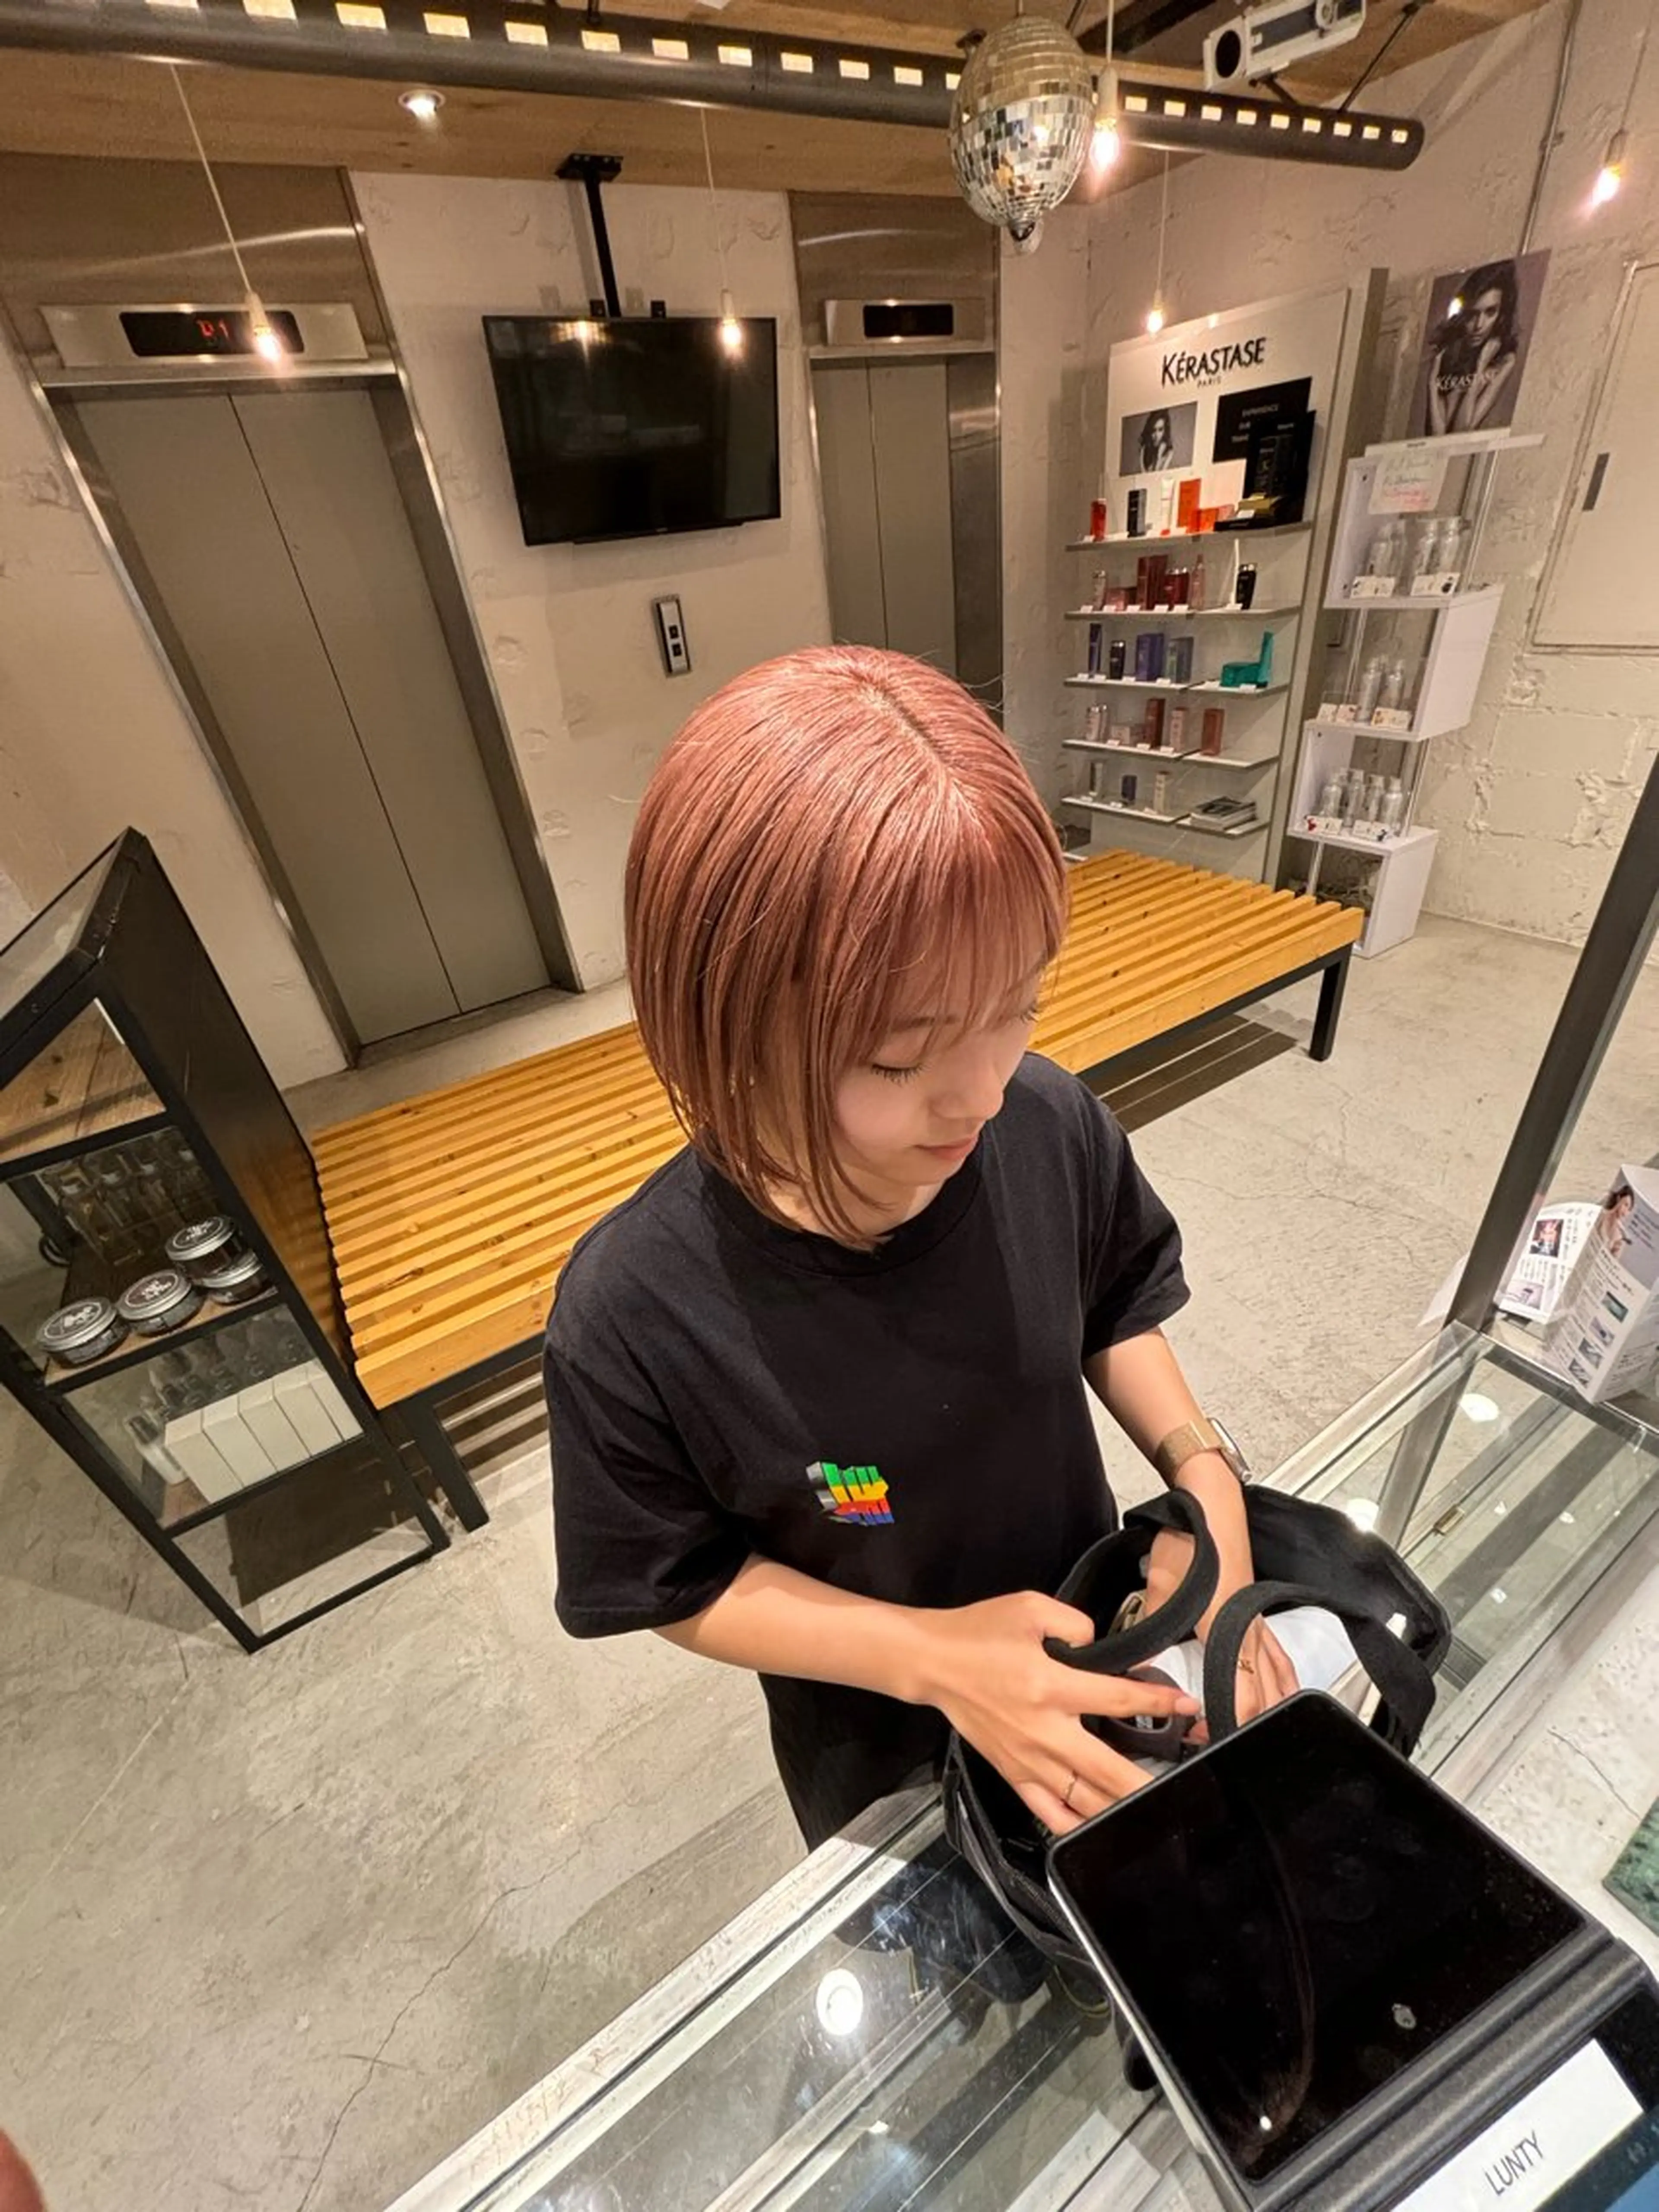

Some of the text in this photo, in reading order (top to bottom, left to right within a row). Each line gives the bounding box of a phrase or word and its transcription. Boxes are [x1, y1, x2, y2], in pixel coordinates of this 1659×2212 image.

[1161, 337, 1266, 388] KÉRASTASE
[1198, 377, 1222, 388] PARIS
[1484, 2129, 1544, 2196] LUNTY
